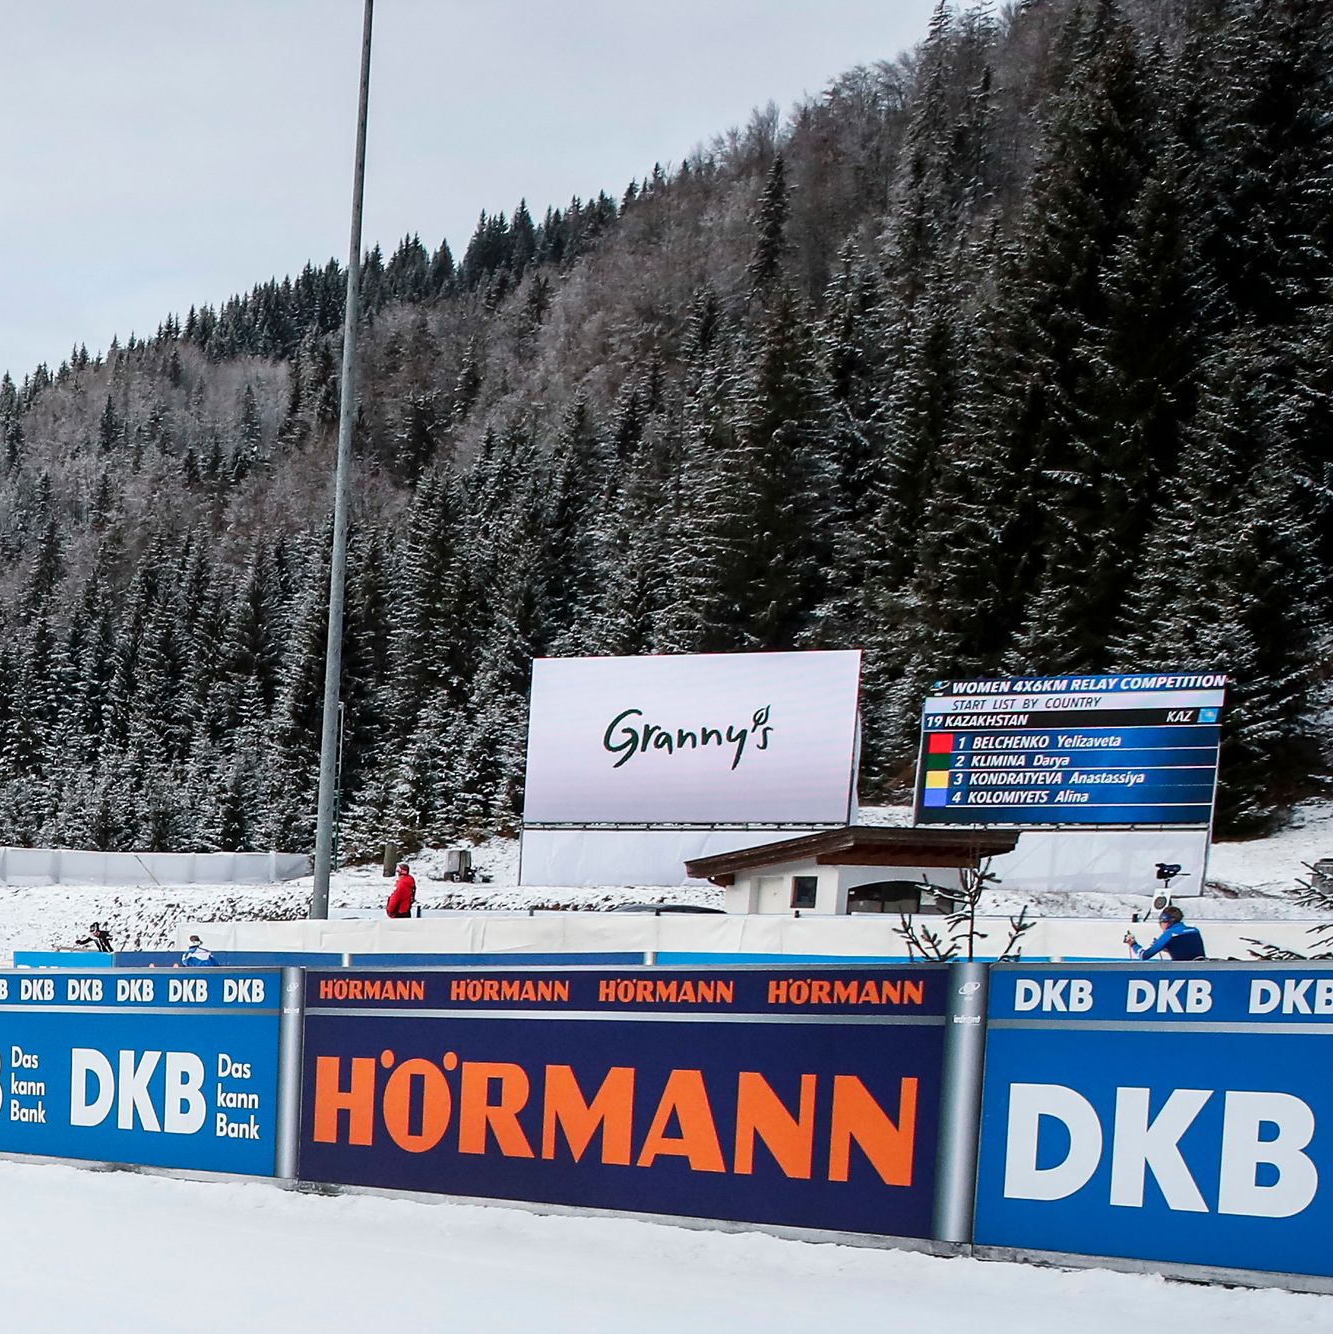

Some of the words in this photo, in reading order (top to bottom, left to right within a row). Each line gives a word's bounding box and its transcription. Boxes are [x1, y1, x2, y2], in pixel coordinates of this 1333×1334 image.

[953, 680, 1010, 694] WOMEN
[1013, 680, 1066, 692] 4X6KM
[1071, 677, 1117, 691] RELAY
[1119, 674, 1227, 689] COMPETITION
[952, 698, 987, 710] START
[993, 699, 1016, 709] LIST
[1024, 699, 1038, 708] BY
[1045, 697, 1101, 708] COUNTRY
[927, 715, 943, 728] 19
[945, 714, 1028, 727] KAZAKHSTAN
[1167, 711, 1192, 722] KAZ
[603, 704, 773, 770] Granny's
[959, 737, 965, 749] 1
[973, 736, 1049, 749] BELCHENKO
[1057, 735, 1122, 748] Yelizaveta
[955, 756, 963, 767] 2
[971, 755, 1025, 767] KLIMINA
[1033, 754, 1069, 768] Darya
[954, 773, 962, 785] 3
[970, 772, 1062, 785] KONDRATYEVA
[1069, 772, 1145, 787] Anastassiya
[953, 791, 961, 803] 4
[968, 791, 1049, 804] KOLOMIYETS
[1055, 790, 1089, 803] Alina
[21, 979, 54, 1001] DKB
[68, 979, 103, 1001] DKB
[117, 979, 154, 1002] DKB
[169, 979, 208, 1002] DKB
[224, 979, 265, 1003] DKB
[320, 979, 424, 1001] HÖRMANN
[451, 979, 569, 1002] HÖRMANN
[599, 979, 733, 1004] HÖRMANN
[768, 979, 923, 1004] HÖRMANN
[1015, 980, 1093, 1012] DKB
[1127, 980, 1212, 1013] DKB
[1249, 979, 1333, 1014] DKB
[11, 1046, 38, 1069] Das
[218, 1054, 251, 1079] Das
[11, 1073, 45, 1096] kann
[71, 1048, 206, 1134] DKB
[217, 1084, 259, 1109] kann
[11, 1101, 46, 1124] Bank
[313, 1049, 918, 1187] HÖRMANN
[216, 1114, 260, 1140] Bank
[1004, 1082, 1318, 1218] DKB
